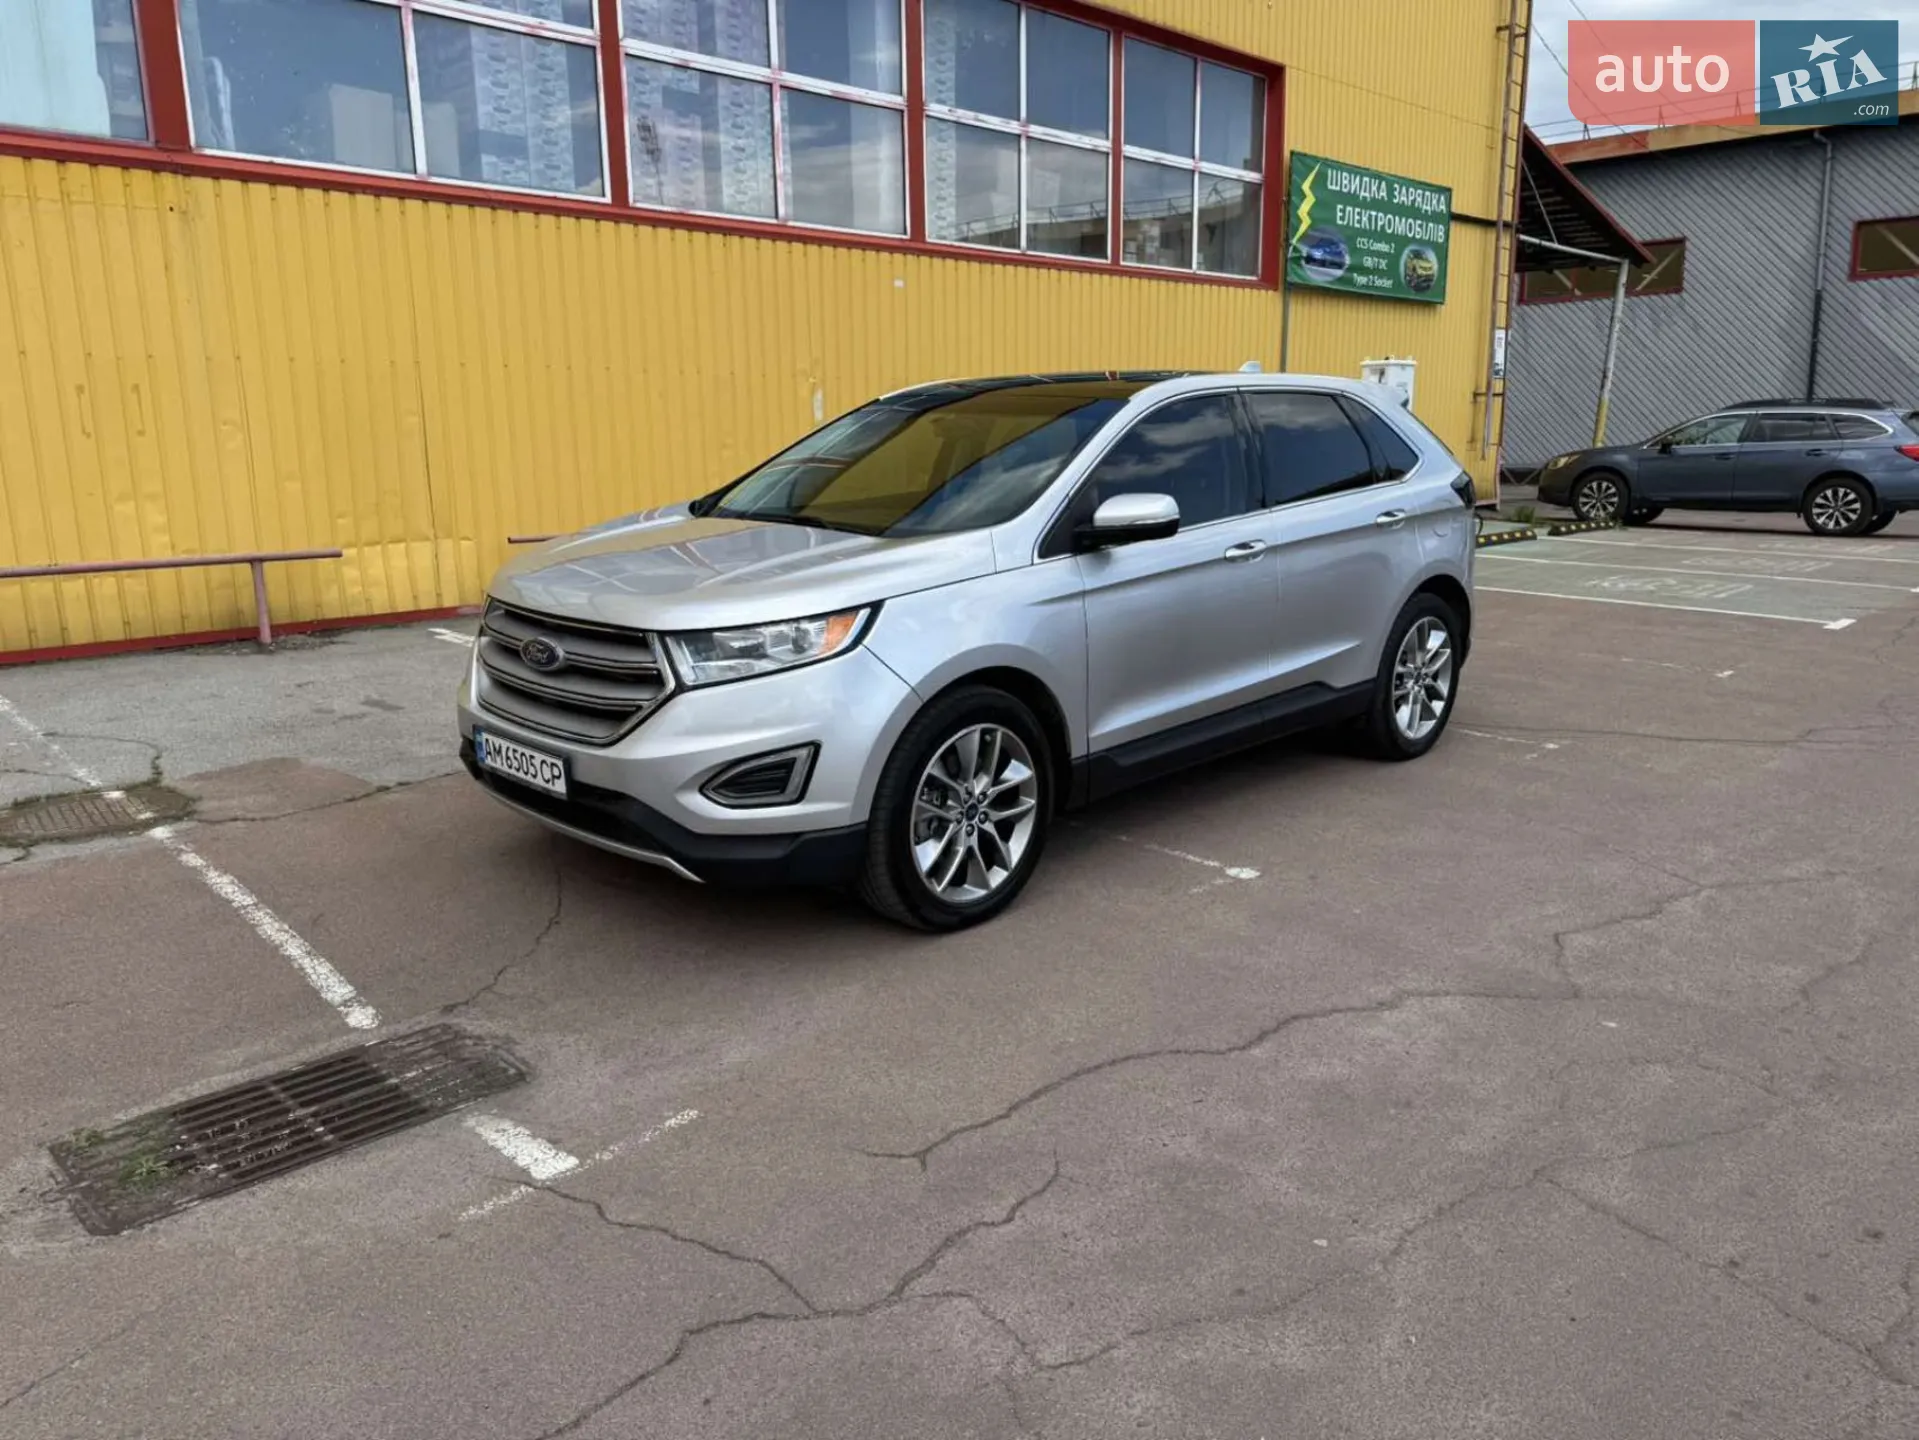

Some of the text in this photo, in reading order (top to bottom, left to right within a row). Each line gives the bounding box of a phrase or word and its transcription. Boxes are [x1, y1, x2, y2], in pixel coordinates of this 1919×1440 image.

[1327, 168, 1446, 214] ШВИДКА ЗАРЯДКА
[1336, 204, 1445, 243] ЕЛЕКТРОМОБІЛІВ
[1356, 237, 1395, 253] CCS Combo 2
[1353, 273, 1368, 287] Type
[1374, 276, 1393, 288] Socket
